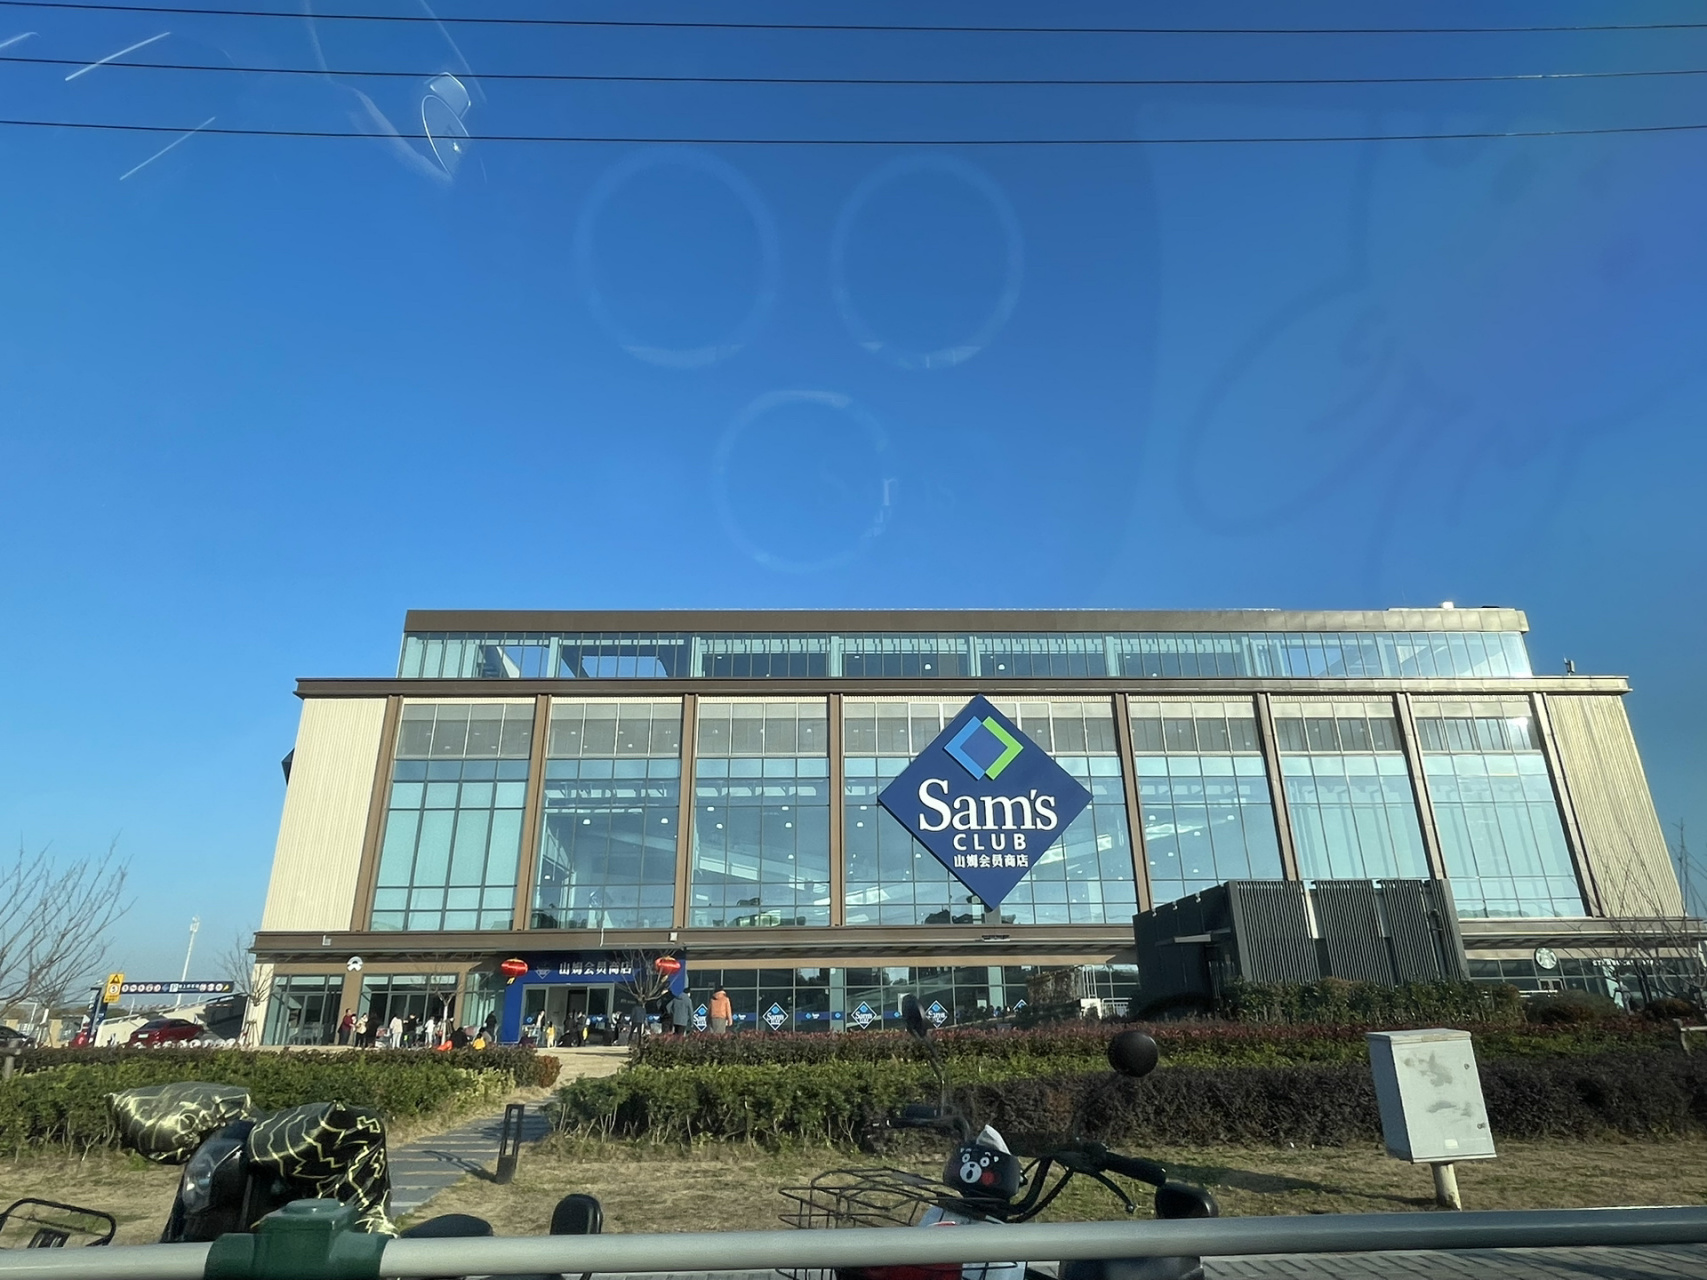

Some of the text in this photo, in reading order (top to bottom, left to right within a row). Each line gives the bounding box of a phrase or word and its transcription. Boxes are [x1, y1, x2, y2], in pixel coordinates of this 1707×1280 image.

[918, 778, 1058, 831] Sam's
[953, 833, 1027, 851] CLUB
[954, 854, 1029, 868] 山姆会员商店
[559, 961, 632, 976] 山姆会员商店
